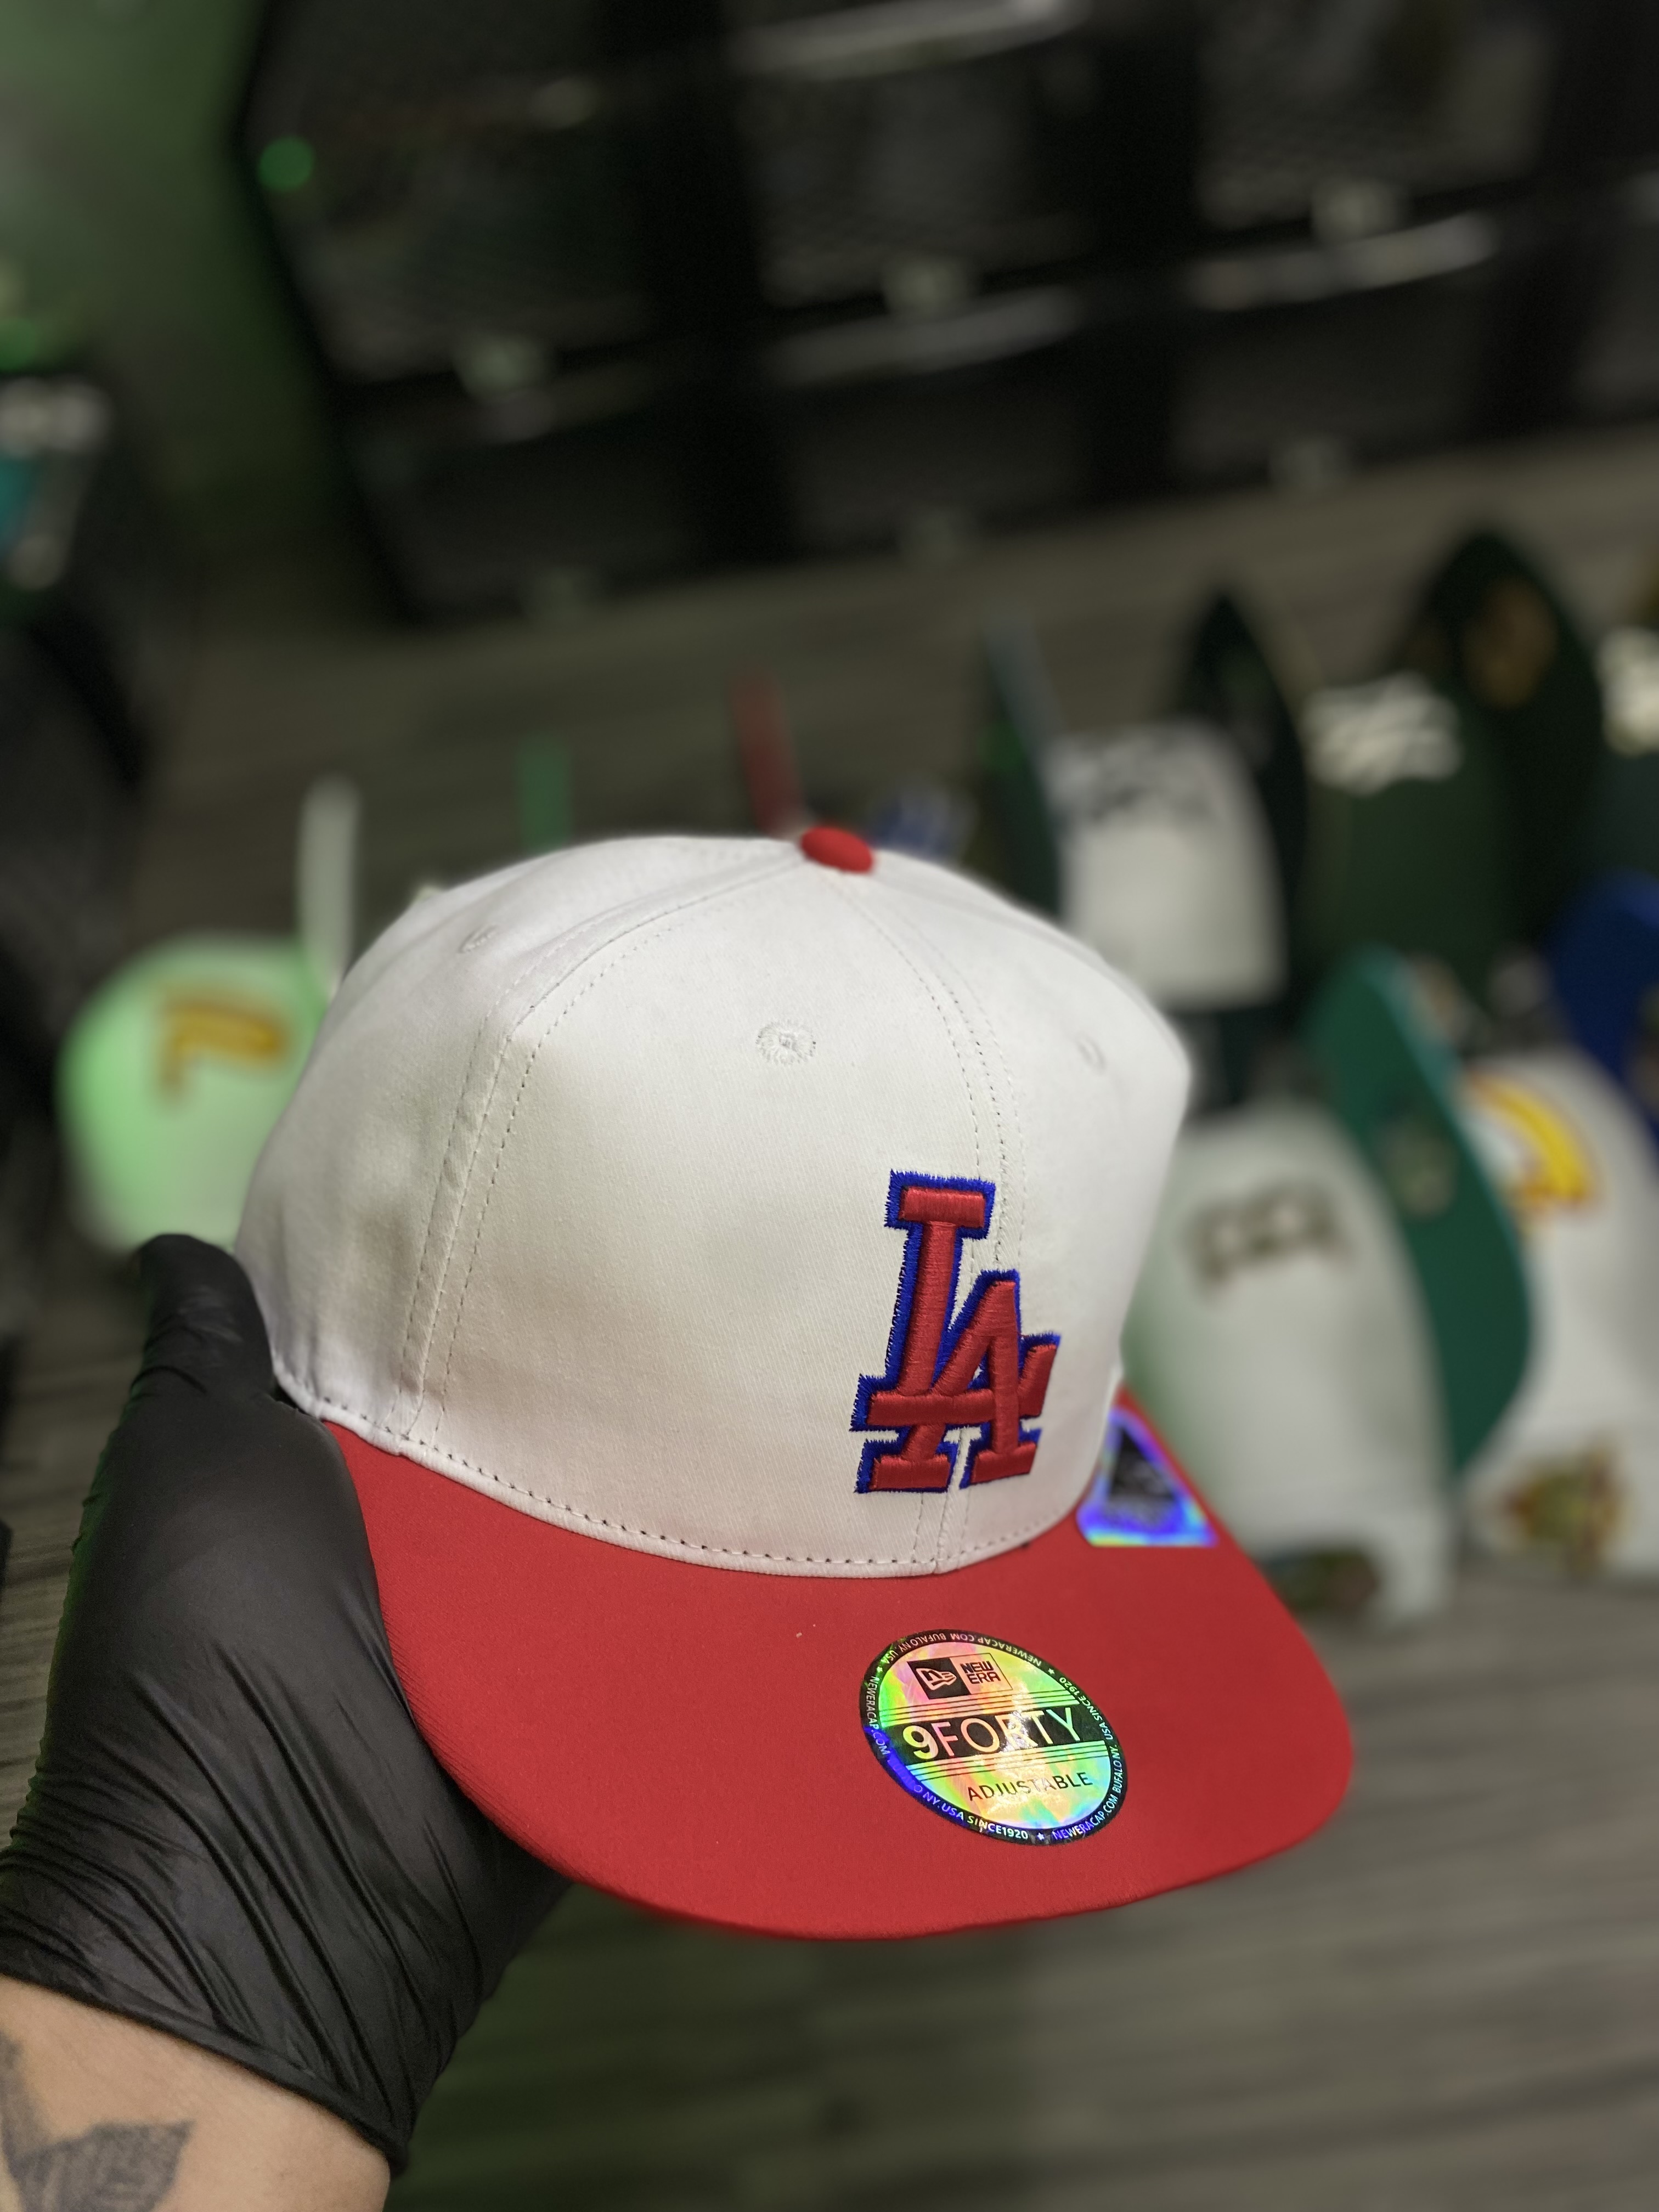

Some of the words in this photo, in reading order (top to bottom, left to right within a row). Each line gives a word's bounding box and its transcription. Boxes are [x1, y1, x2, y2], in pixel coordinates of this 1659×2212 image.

[850, 1169, 1061, 1494] LA
[910, 1633, 947, 1646] BUFALO
[881, 1650, 899, 1664] USA
[960, 1661, 995, 1673] NEW
[966, 1672, 1001, 1684] ERA
[902, 1707, 1081, 1759] 9FORTY
[1099, 1722, 1114, 1740] USA
[1112, 1760, 1123, 1794] BUFALO
[967, 1772, 1093, 1801] ADJUSTABLE
